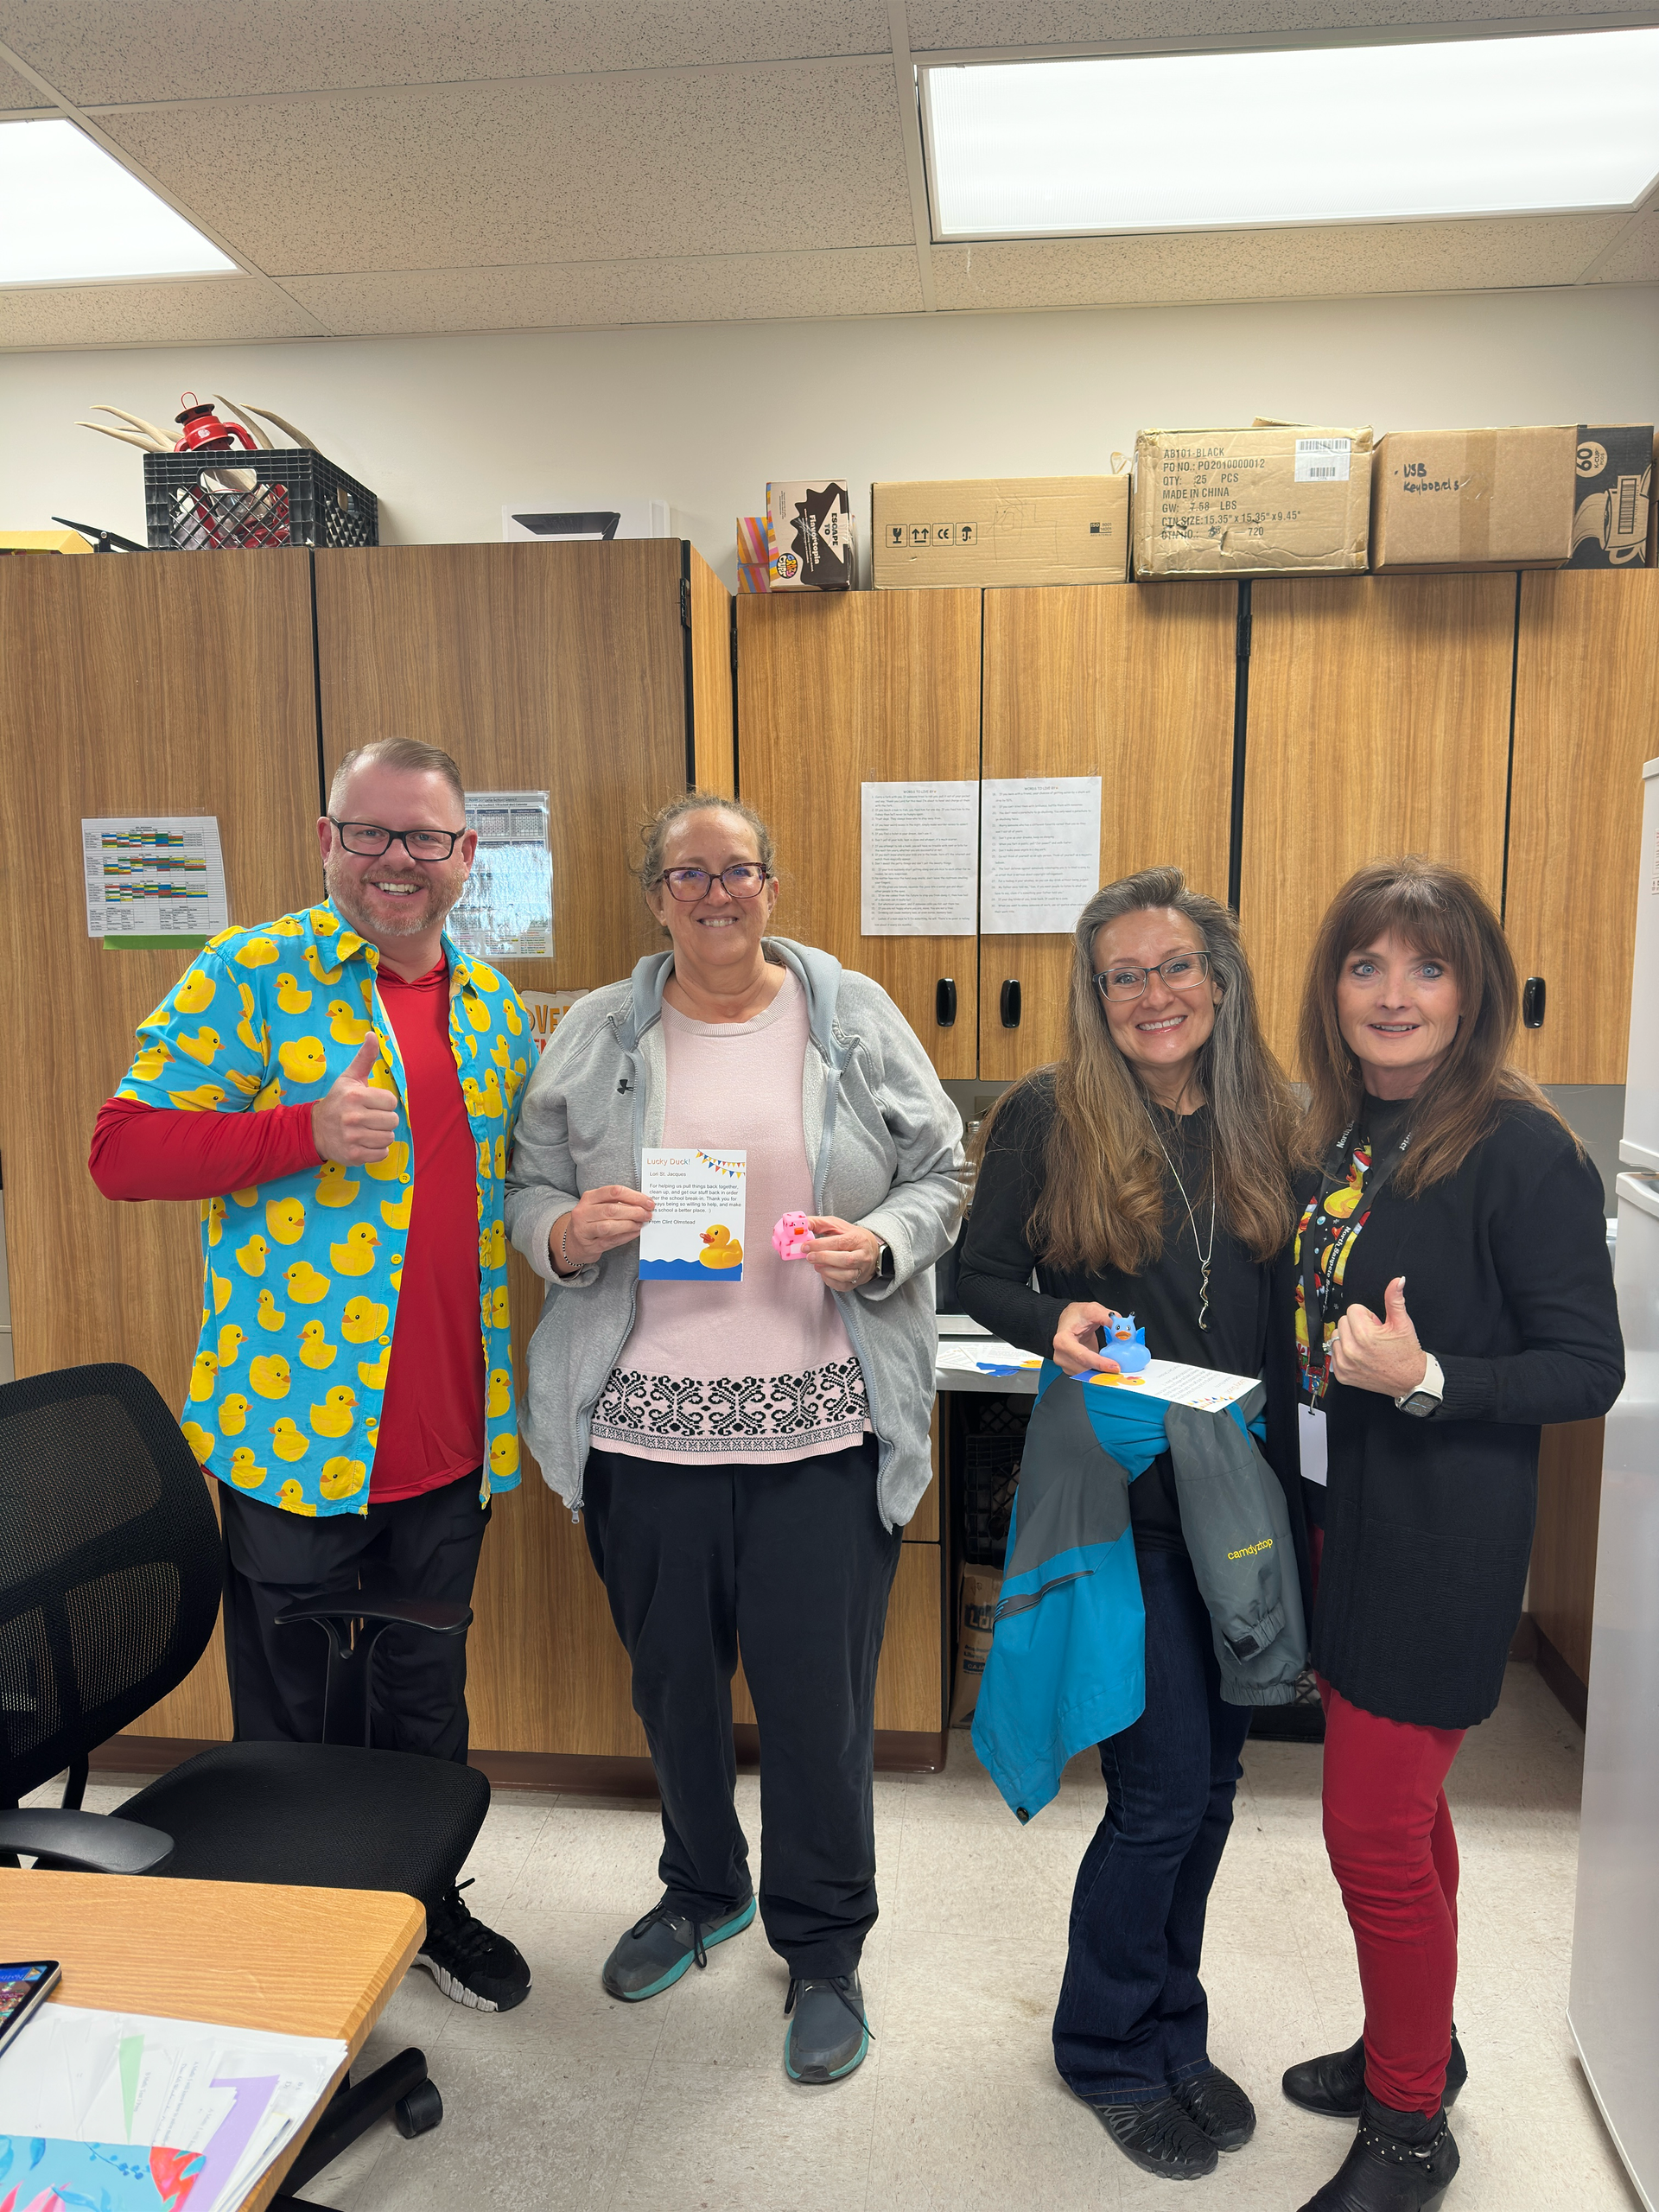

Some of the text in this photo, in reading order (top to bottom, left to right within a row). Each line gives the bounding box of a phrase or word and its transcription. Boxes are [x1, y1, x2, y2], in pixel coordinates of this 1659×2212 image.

[1164, 448, 1224, 458] AB101-BLACK
[1163, 462, 1174, 472] PO
[1177, 461, 1195, 471] NO.:
[1403, 463, 1427, 478] USB
[1163, 474, 1239, 486] QTY: 25 PCS
[1162, 487, 1230, 499] MADE IN CHINA
[1162, 500, 1237, 513] GW: 7.58 LBS
[824, 524, 830, 536] TO
[1248, 527, 1264, 537] 720
[809, 515, 820, 565] Flavortopia
[777, 555, 786, 577] CUPS
[785, 554, 798, 577] CRAZY
[525, 1005, 570, 1033] VE
[1337, 1226, 1351, 1248] North
[1326, 1247, 1340, 1278] Sanpete
[1227, 1538, 1274, 1560] camdyztop
